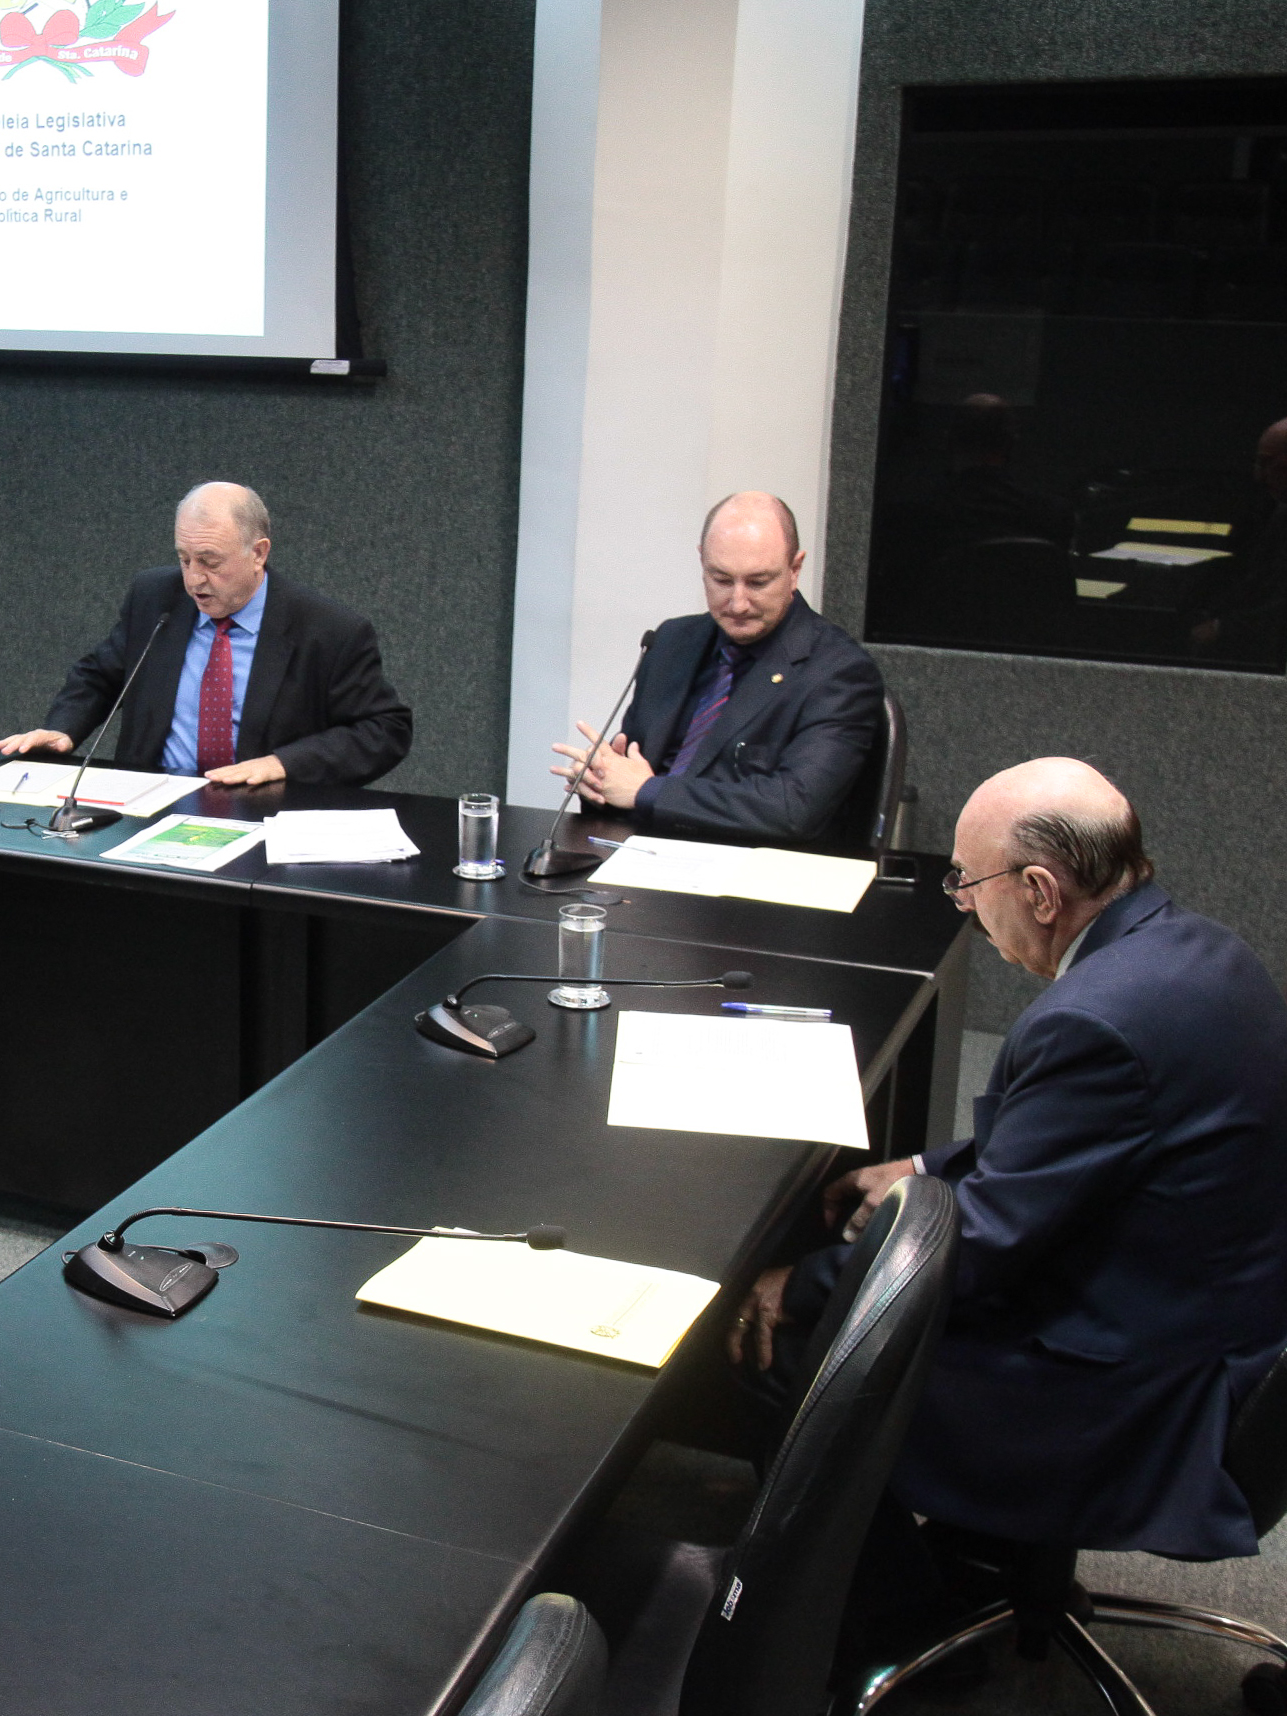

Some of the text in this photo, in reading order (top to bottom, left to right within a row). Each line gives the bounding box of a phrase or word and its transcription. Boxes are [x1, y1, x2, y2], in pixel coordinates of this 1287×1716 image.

[57, 50, 81, 60] Sta.
[83, 45, 139, 60] Catarina
[35, 112, 126, 132] Legislativa
[4, 143, 24, 157] de
[30, 142, 76, 157] Santa
[82, 140, 152, 156] Catarina
[12, 188, 29, 202] de
[34, 187, 115, 204] Agricultura
[120, 190, 128, 201] e
[44, 208, 82, 222] Rural
